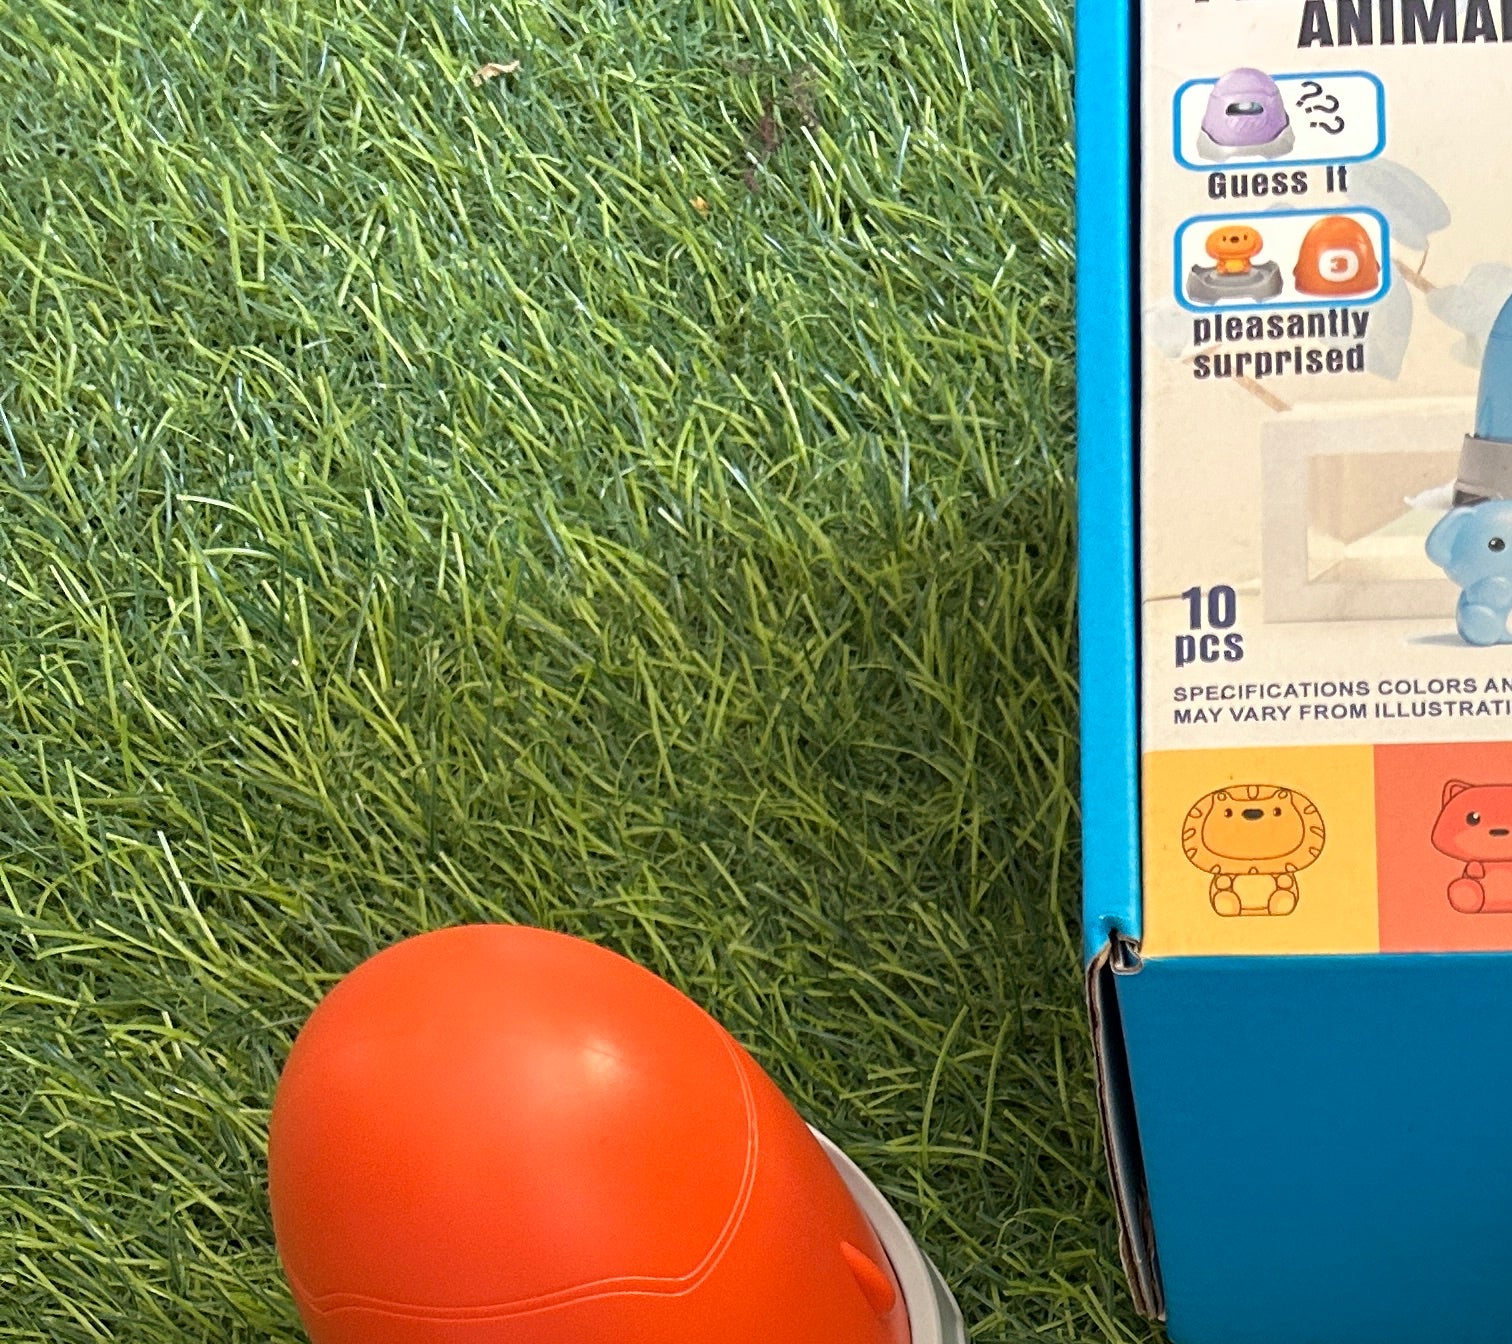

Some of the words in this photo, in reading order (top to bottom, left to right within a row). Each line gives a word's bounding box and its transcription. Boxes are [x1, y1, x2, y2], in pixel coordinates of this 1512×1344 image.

[1208, 170, 1308, 200] Guess
[1193, 307, 1370, 346] pleasantly
[1193, 343, 1365, 379] surprised
[1181, 584, 1237, 630] 10
[1175, 632, 1244, 668] pcs
[1173, 680, 1371, 702] SPECIFICATIONS
[1378, 677, 1478, 696] COLORS
[1174, 706, 1223, 724] MAY
[1229, 704, 1292, 723] VARY
[1299, 701, 1368, 720] FROM
